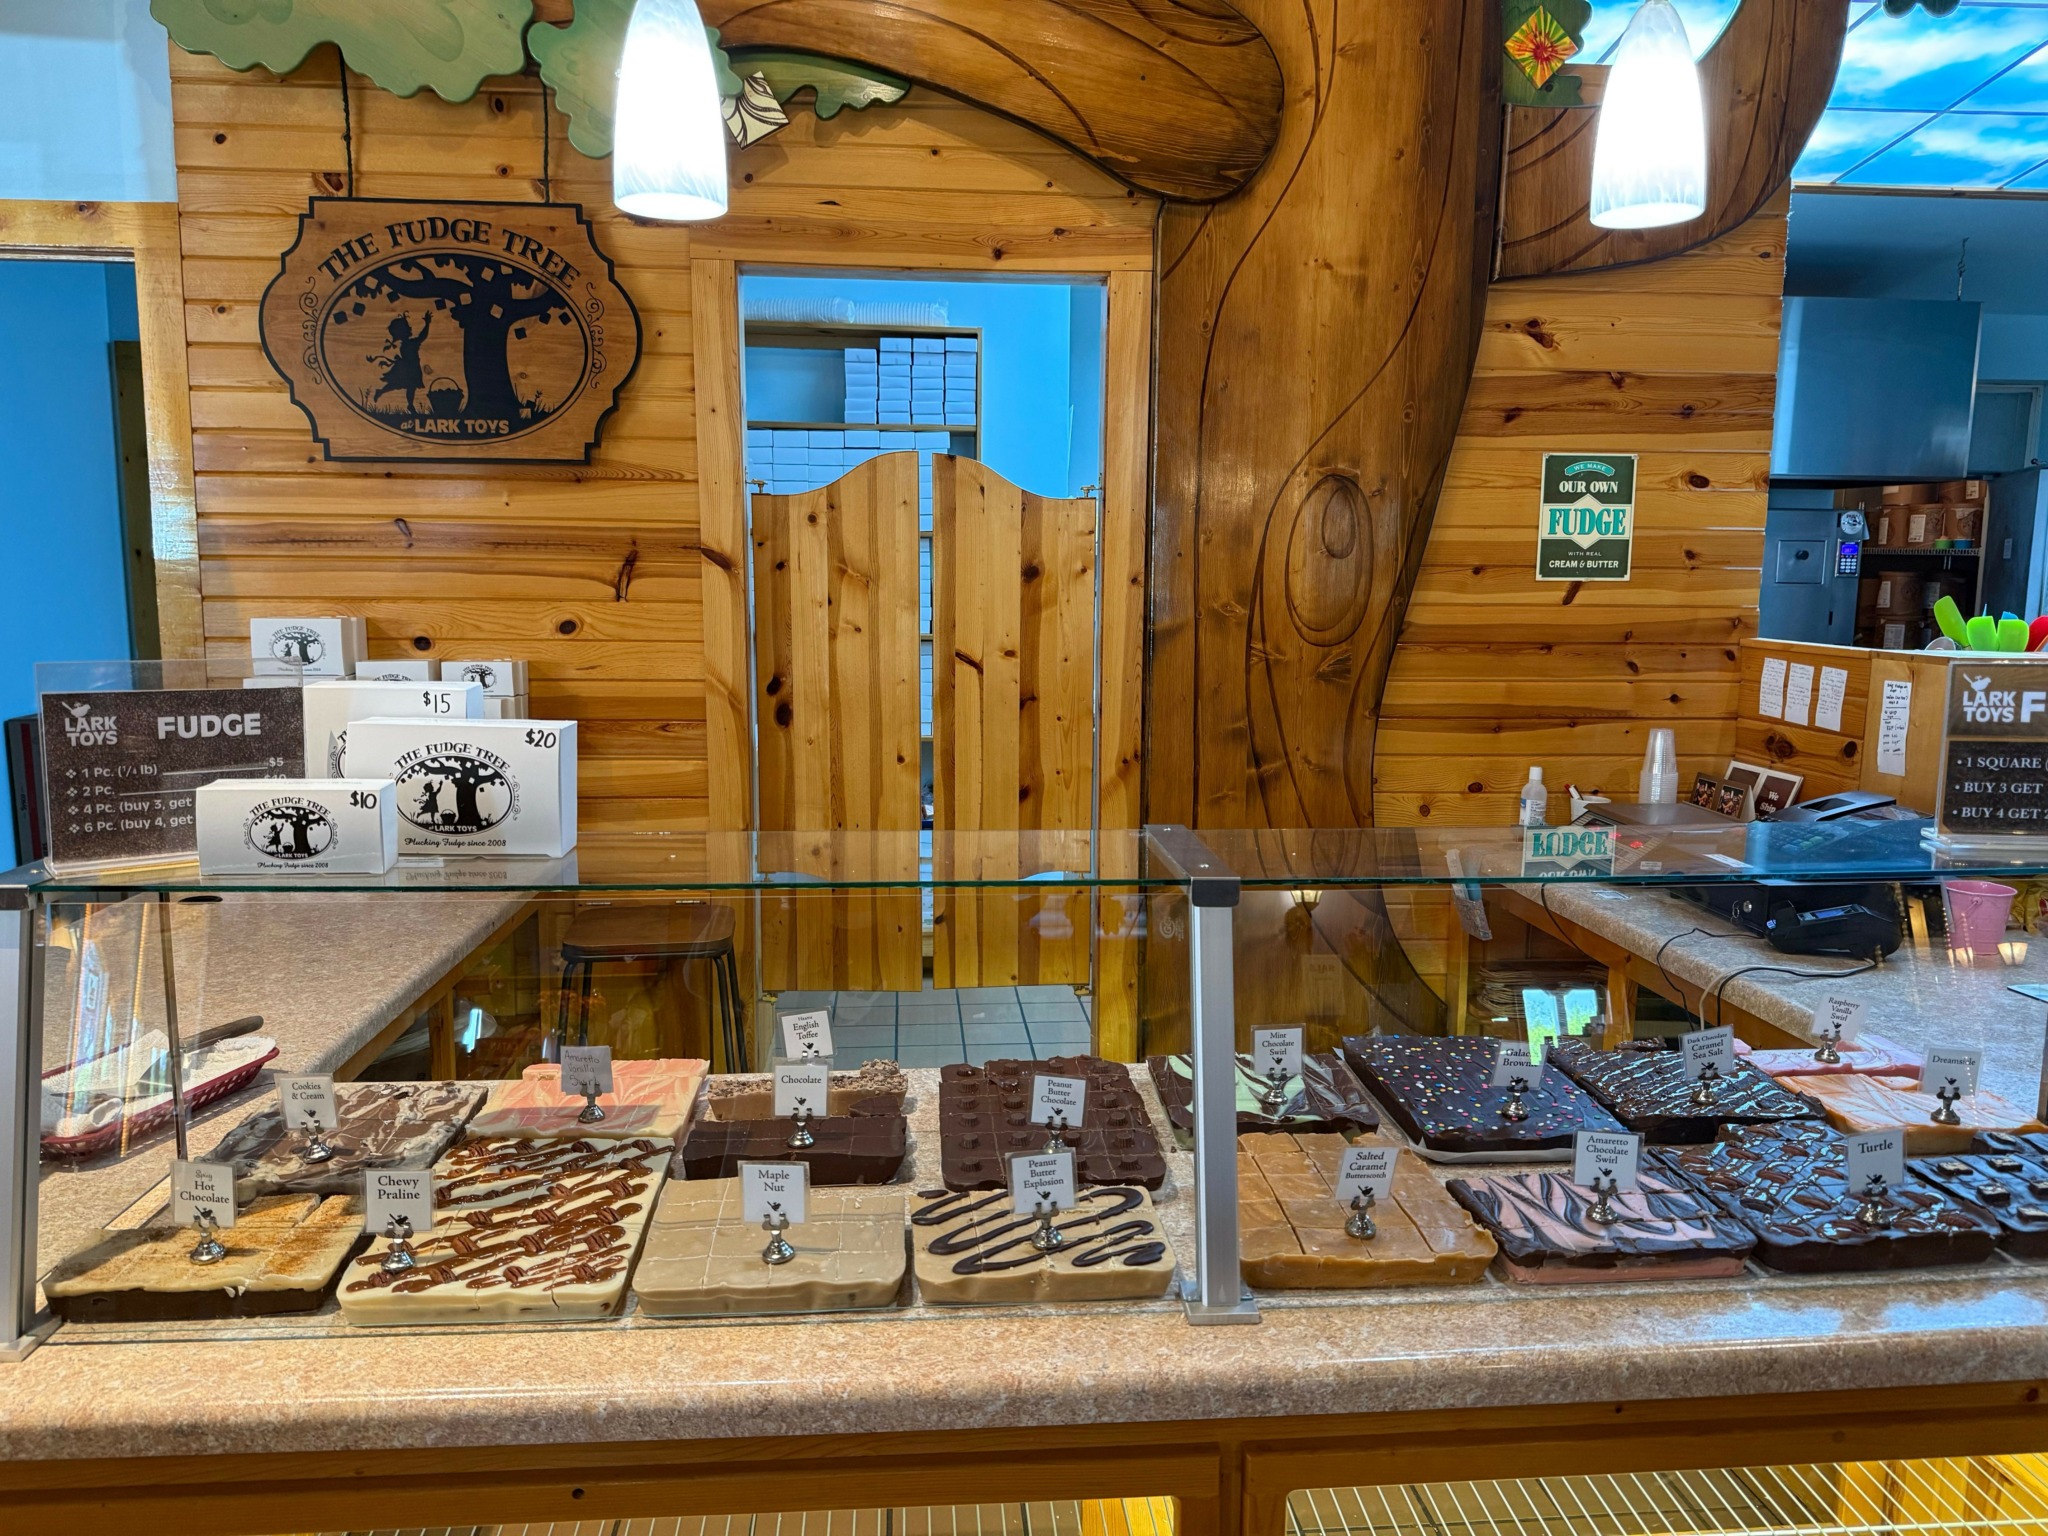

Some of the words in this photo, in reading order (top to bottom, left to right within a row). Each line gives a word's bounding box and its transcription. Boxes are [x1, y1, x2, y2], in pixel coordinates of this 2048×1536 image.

[317, 232, 379, 283] THE
[386, 216, 492, 249] FUDGE
[501, 228, 581, 290] TREE
[400, 419, 414, 431] at
[415, 419, 460, 433] LARK
[464, 419, 510, 434] TOYS
[1587, 463, 1606, 472] MAKE
[1559, 481, 1586, 493] OUR
[1590, 481, 1618, 493] OWN
[1548, 508, 1626, 536] FUDGE
[1549, 560, 1578, 568] CREAM
[1579, 560, 1586, 568] &
[1587, 560, 1619, 568] BUTTER
[422, 690, 452, 714] $15
[1962, 691, 2017, 706] LARK
[1962, 707, 2014, 723] TOYS
[65, 716, 118, 731] LARK
[157, 713, 261, 740] FUDGE
[66, 731, 118, 747] TOYS
[524, 728, 557, 749] $20
[394, 748, 422, 770] THE
[425, 742, 472, 756] FUDGE
[475, 747, 511, 773] TREE
[81, 768, 89, 778] 1
[94, 767, 114, 778] Pc.
[140, 764, 158, 776] lb)
[268, 757, 284, 767] $5
[1966, 757, 1972, 767] 1
[1977, 757, 2042, 771] SQUARE
[83, 787, 91, 797] 2
[95, 786, 115, 796] Pc.
[1963, 782, 1996, 793] BUY
[1999, 783, 2007, 793] 3
[2011, 783, 2044, 794] GET
[350, 790, 377, 809] $10
[1768, 791, 1779, 801] We
[83, 804, 92, 815] 4
[96, 803, 115, 814] Pc.
[119, 800, 150, 814] (buy
[154, 800, 166, 811] 3,
[169, 797, 193, 811] get
[249, 801, 270, 817] THE
[271, 796, 305, 806] FUDGE
[307, 799, 331, 817] TREE
[1759, 802, 1776, 814] Ship
[1961, 807, 1993, 818] BUY
[1996, 808, 2004, 818] 4
[2008, 808, 2041, 819] GET
[84, 823, 93, 833] 6
[97, 822, 117, 832] Pc.
[120, 819, 151, 832] (buy
[155, 818, 167, 829] 4,
[170, 815, 194, 828] get
[405, 838, 441, 848] Plucking
[442, 838, 466, 848] Fudge
[1828, 997, 1861, 1010] Raspberry
[1831, 1006, 1852, 1015] Vanilla
[1830, 1013, 1848, 1022] Swirl
[793, 1021, 819, 1032] English
[796, 1031, 818, 1040] Toffee
[1701, 1032, 1728, 1042] Chocolate
[1691, 1040, 1724, 1052] Caramel
[1269, 1048, 1287, 1056] Swirl
[1692, 1051, 1706, 1060] Sea
[1708, 1049, 1724, 1058] Salt
[781, 1075, 821, 1084] Chocolate
[1047, 1079, 1072, 1088] Peanut
[292, 1082, 321, 1091] Cookies
[292, 1092, 298, 1100] &
[300, 1092, 325, 1100] Cream
[1047, 1088, 1071, 1097] Butter
[1040, 1096, 1077, 1105] Chocolate
[1587, 1136, 1629, 1146] Amaretto
[1586, 1145, 1629, 1156] Chocolate
[1858, 1140, 1894, 1154] Turtle
[1356, 1152, 1385, 1160] Salted
[1595, 1155, 1618, 1164] Swirl
[1028, 1160, 1057, 1168] Peanut
[1349, 1162, 1387, 1171] Caramel
[758, 1169, 789, 1180] Maple
[1030, 1168, 1056, 1178] Butter
[194, 1180, 215, 1191] Hot
[378, 1175, 419, 1189] Chewy
[764, 1182, 784, 1192] Nut
[1023, 1178, 1064, 1190] Explosion
[180, 1191, 230, 1204] Chocolate
[378, 1189, 420, 1200] Praline
